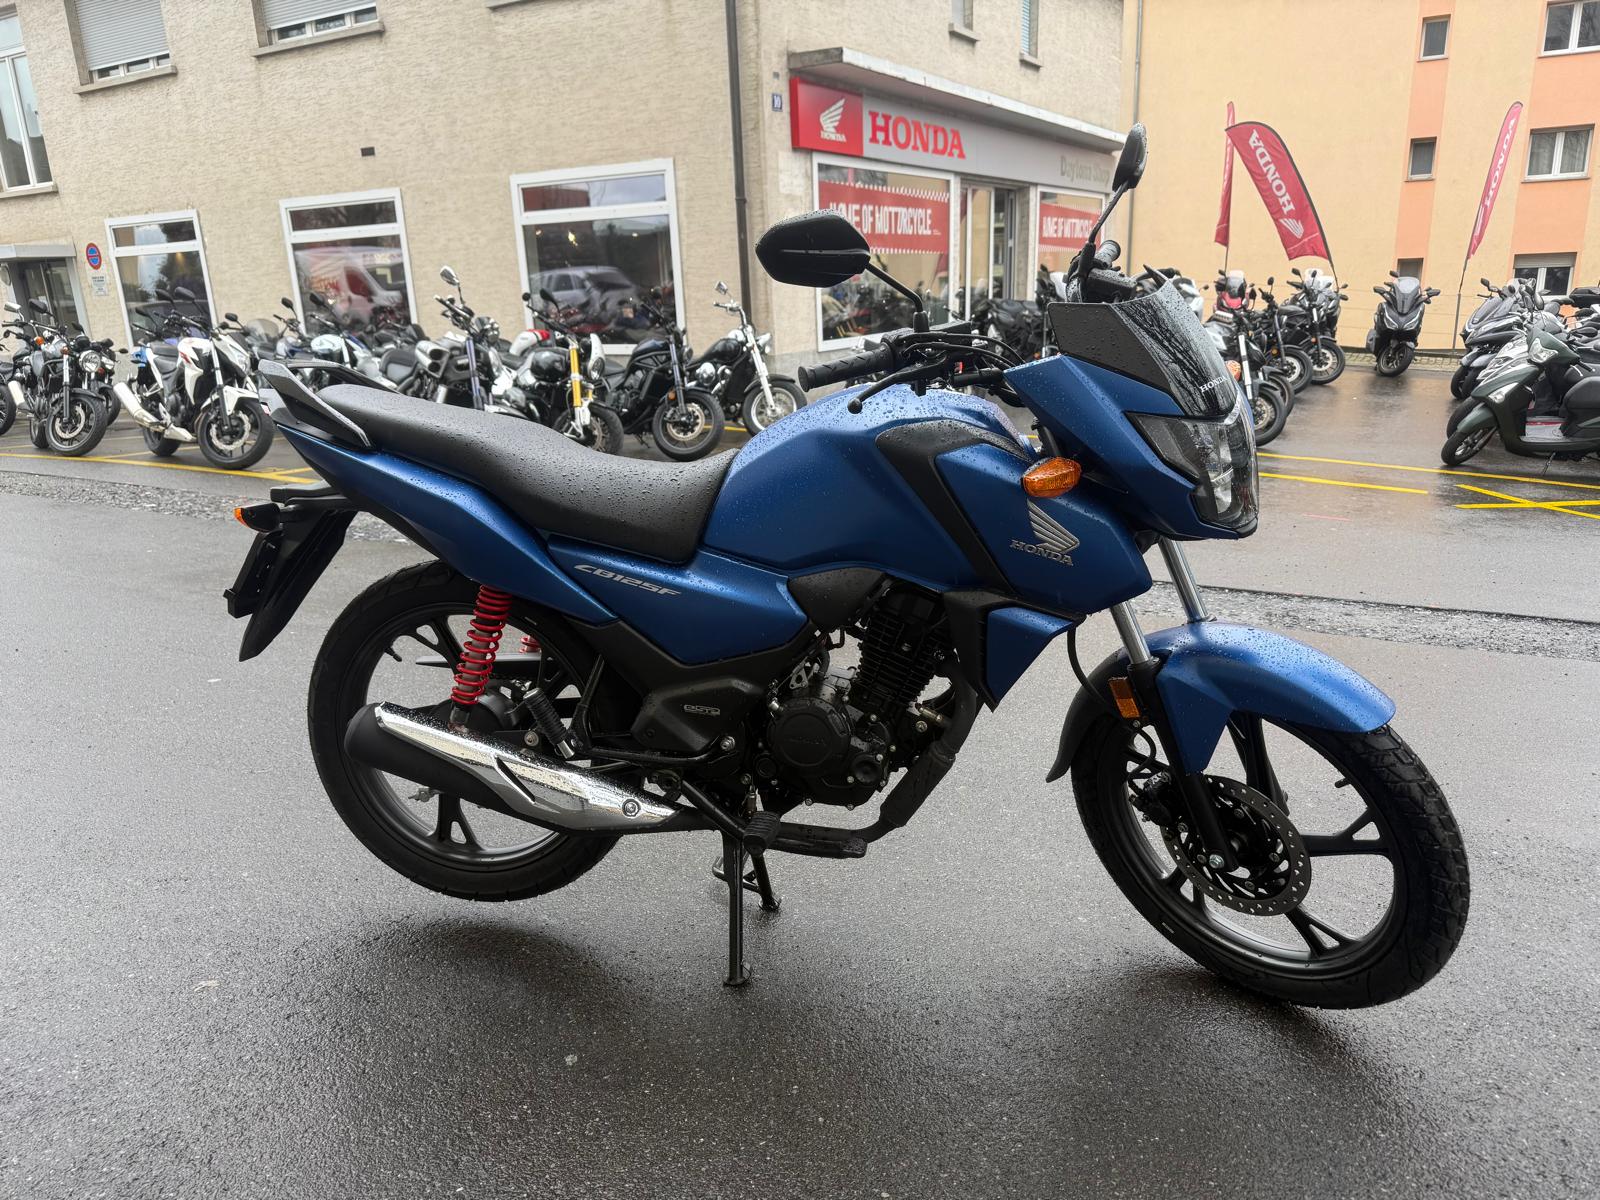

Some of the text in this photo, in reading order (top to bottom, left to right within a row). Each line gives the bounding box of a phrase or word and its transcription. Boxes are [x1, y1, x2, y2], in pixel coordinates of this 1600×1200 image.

[820, 130, 847, 143] HONDA
[868, 111, 966, 160] HONDA
[1248, 129, 1296, 215] HONDA
[1485, 118, 1516, 209] HONDA
[861, 204, 873, 234] OF
[1200, 376, 1227, 392] HONDA
[1009, 539, 1074, 567] HONDA
[574, 564, 682, 596] CB125F
